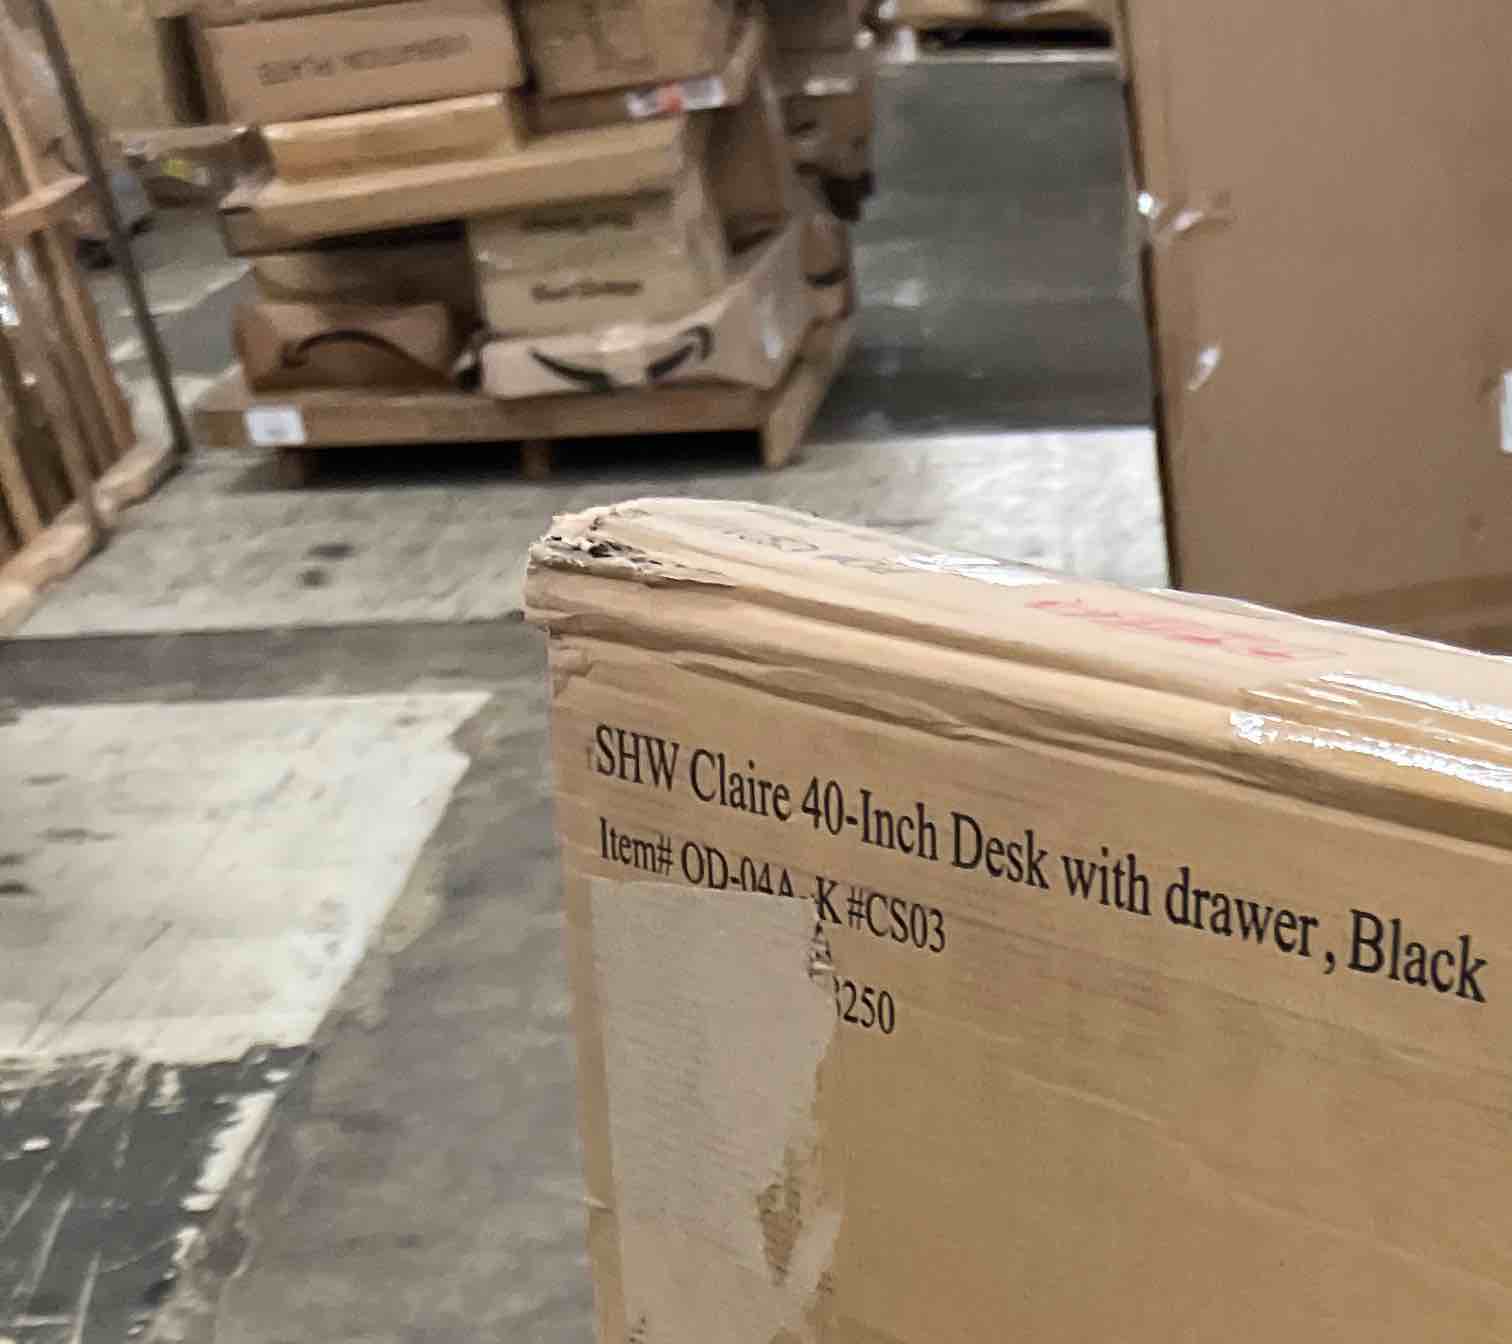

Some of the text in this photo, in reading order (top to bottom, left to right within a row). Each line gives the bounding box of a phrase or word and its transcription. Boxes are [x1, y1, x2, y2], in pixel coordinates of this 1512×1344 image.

[595, 723, 680, 793] SHW
[690, 748, 792, 823] Claire
[800, 776, 938, 861] 40-Inch
[951, 810, 1050, 890] Desk
[1061, 846, 1151, 917] with
[1347, 908, 1488, 1004] Black
[599, 816, 674, 876] Item#
